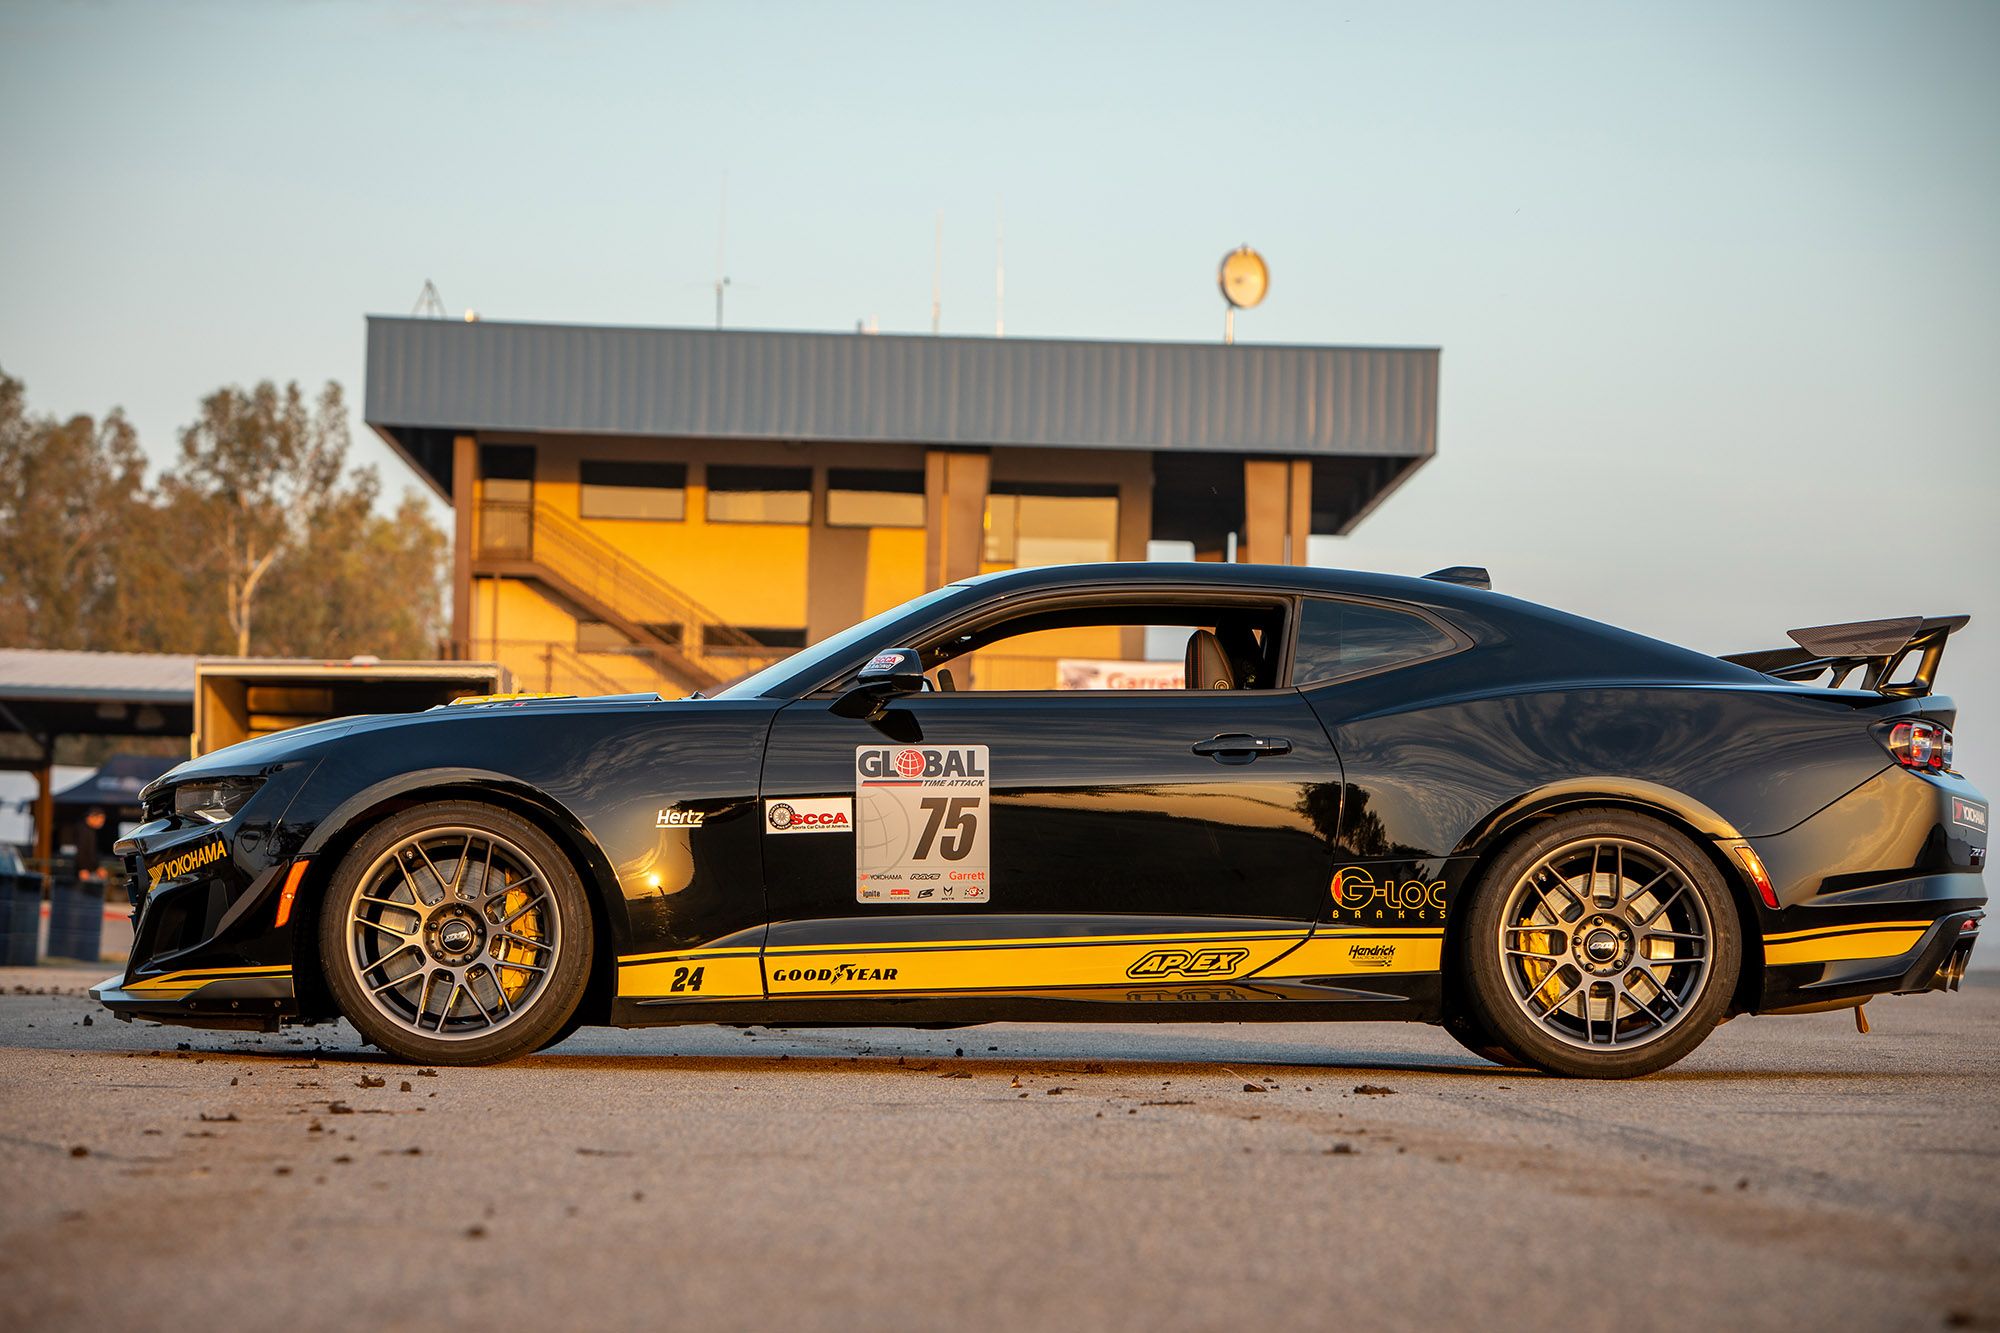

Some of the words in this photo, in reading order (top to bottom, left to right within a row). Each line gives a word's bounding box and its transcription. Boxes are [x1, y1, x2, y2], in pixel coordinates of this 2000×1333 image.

[858, 750, 985, 778] GLOBAL
[656, 809, 705, 826] Hertz
[790, 812, 848, 825] SCCA
[912, 797, 981, 861] 75
[165, 840, 228, 881] YOKOHAMA
[949, 870, 985, 881] Garrett
[1331, 866, 1446, 910] G-LOC
[1332, 910, 1446, 919] BRAKES
[1131, 950, 1246, 976] APEX
[1348, 945, 1396, 959] Hendrick
[670, 967, 705, 992] 24
